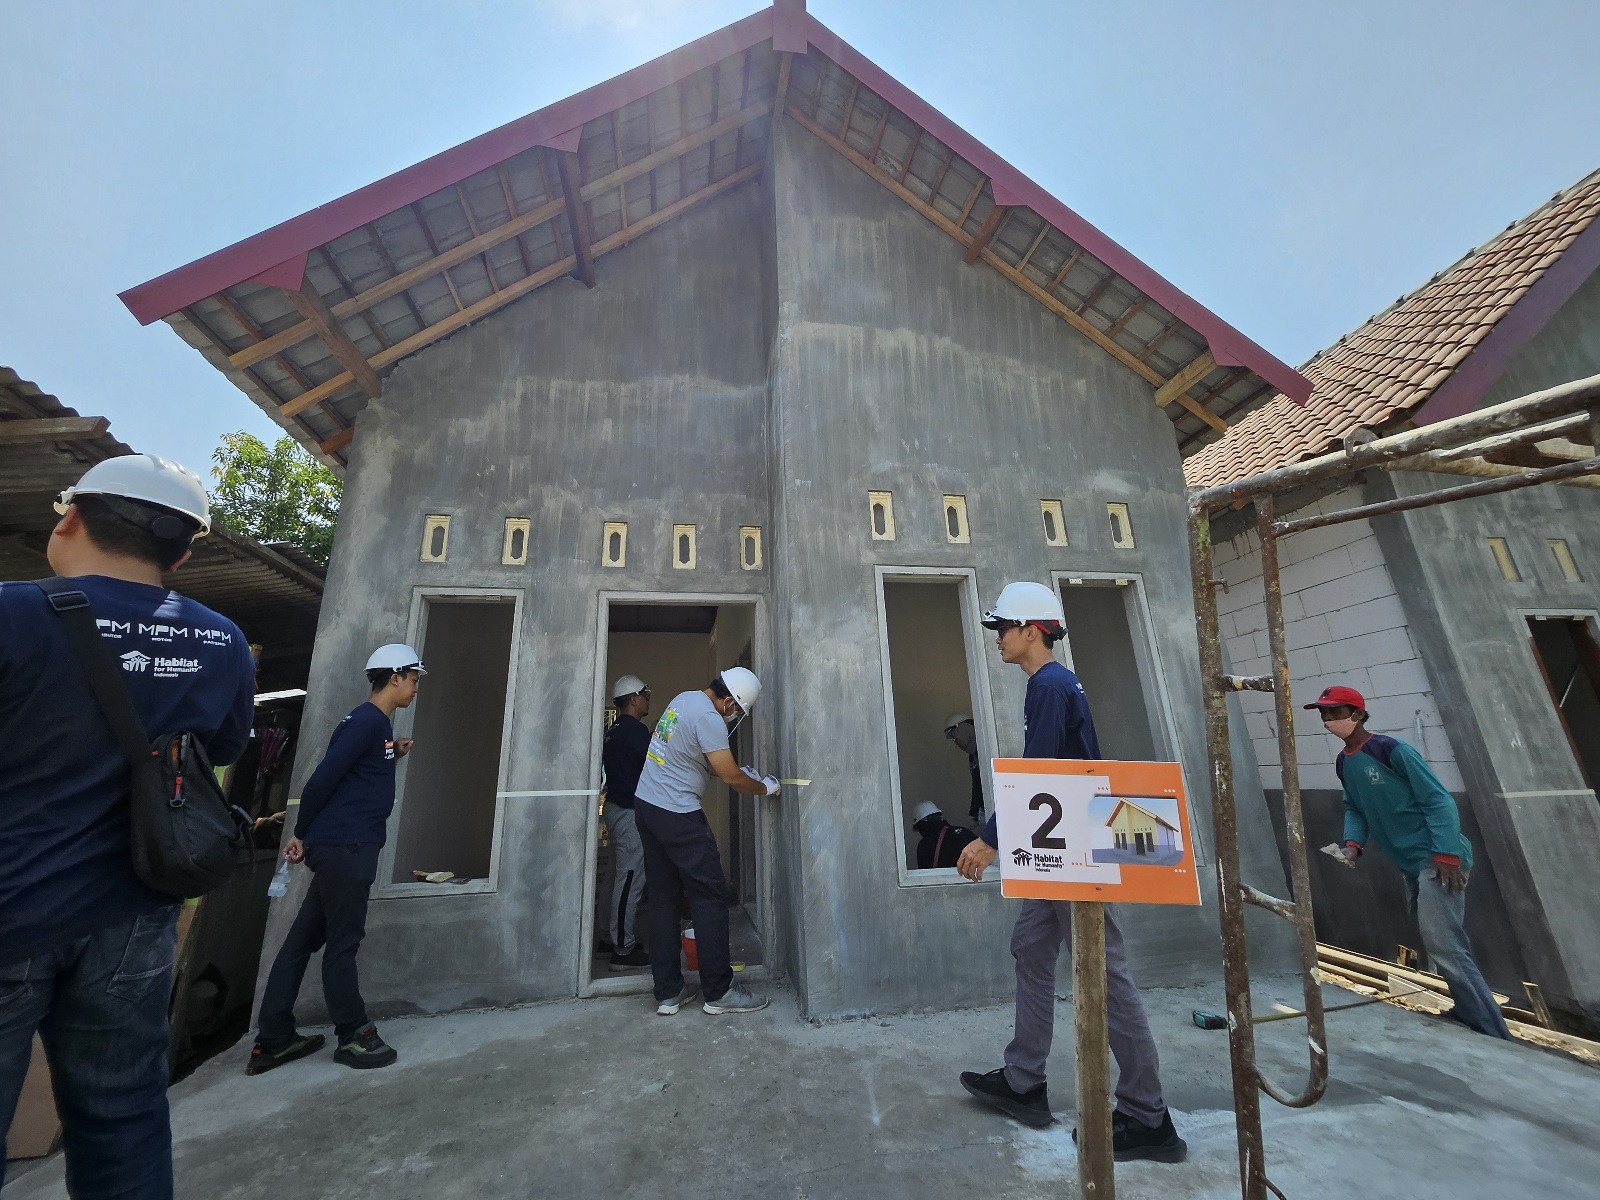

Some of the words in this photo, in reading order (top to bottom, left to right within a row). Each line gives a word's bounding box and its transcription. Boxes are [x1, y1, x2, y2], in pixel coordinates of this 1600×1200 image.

[95, 619, 130, 634] PM
[138, 623, 188, 638] MPM
[194, 628, 232, 643] MPM
[154, 657, 199, 667] Habitat
[1028, 792, 1067, 850] 2
[1034, 853, 1063, 863] Habitat
